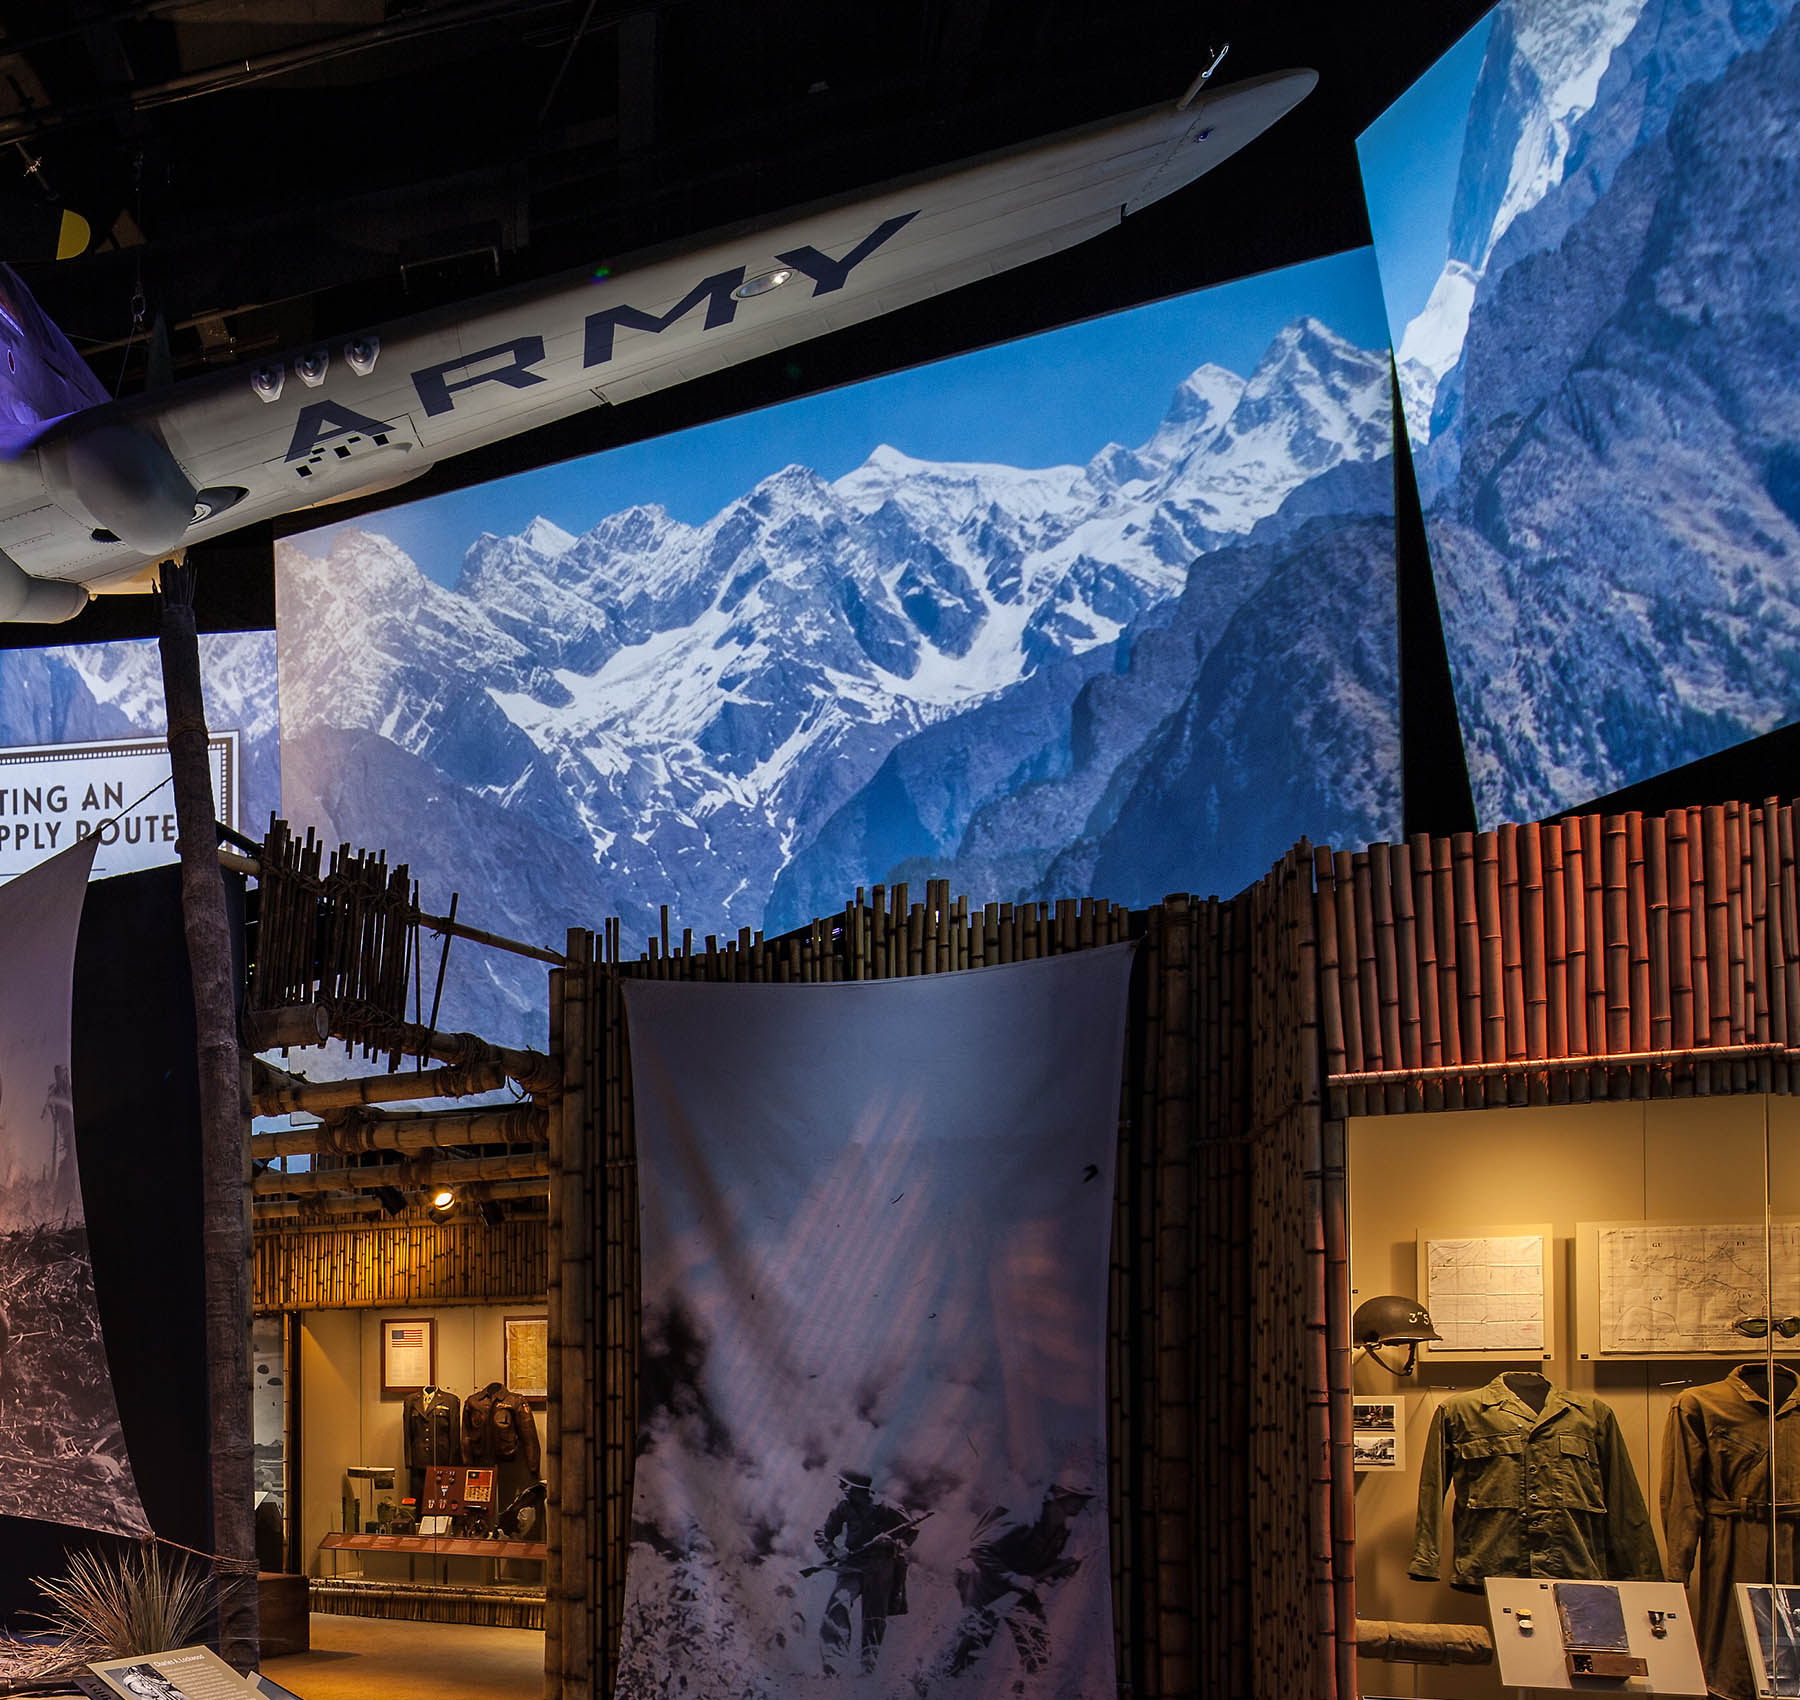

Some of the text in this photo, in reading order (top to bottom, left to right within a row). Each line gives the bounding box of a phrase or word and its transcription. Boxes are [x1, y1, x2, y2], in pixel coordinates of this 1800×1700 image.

[284, 210, 922, 463] ARMY
[81, 781, 123, 811] AN
[76, 815, 176, 846] ROUTE
